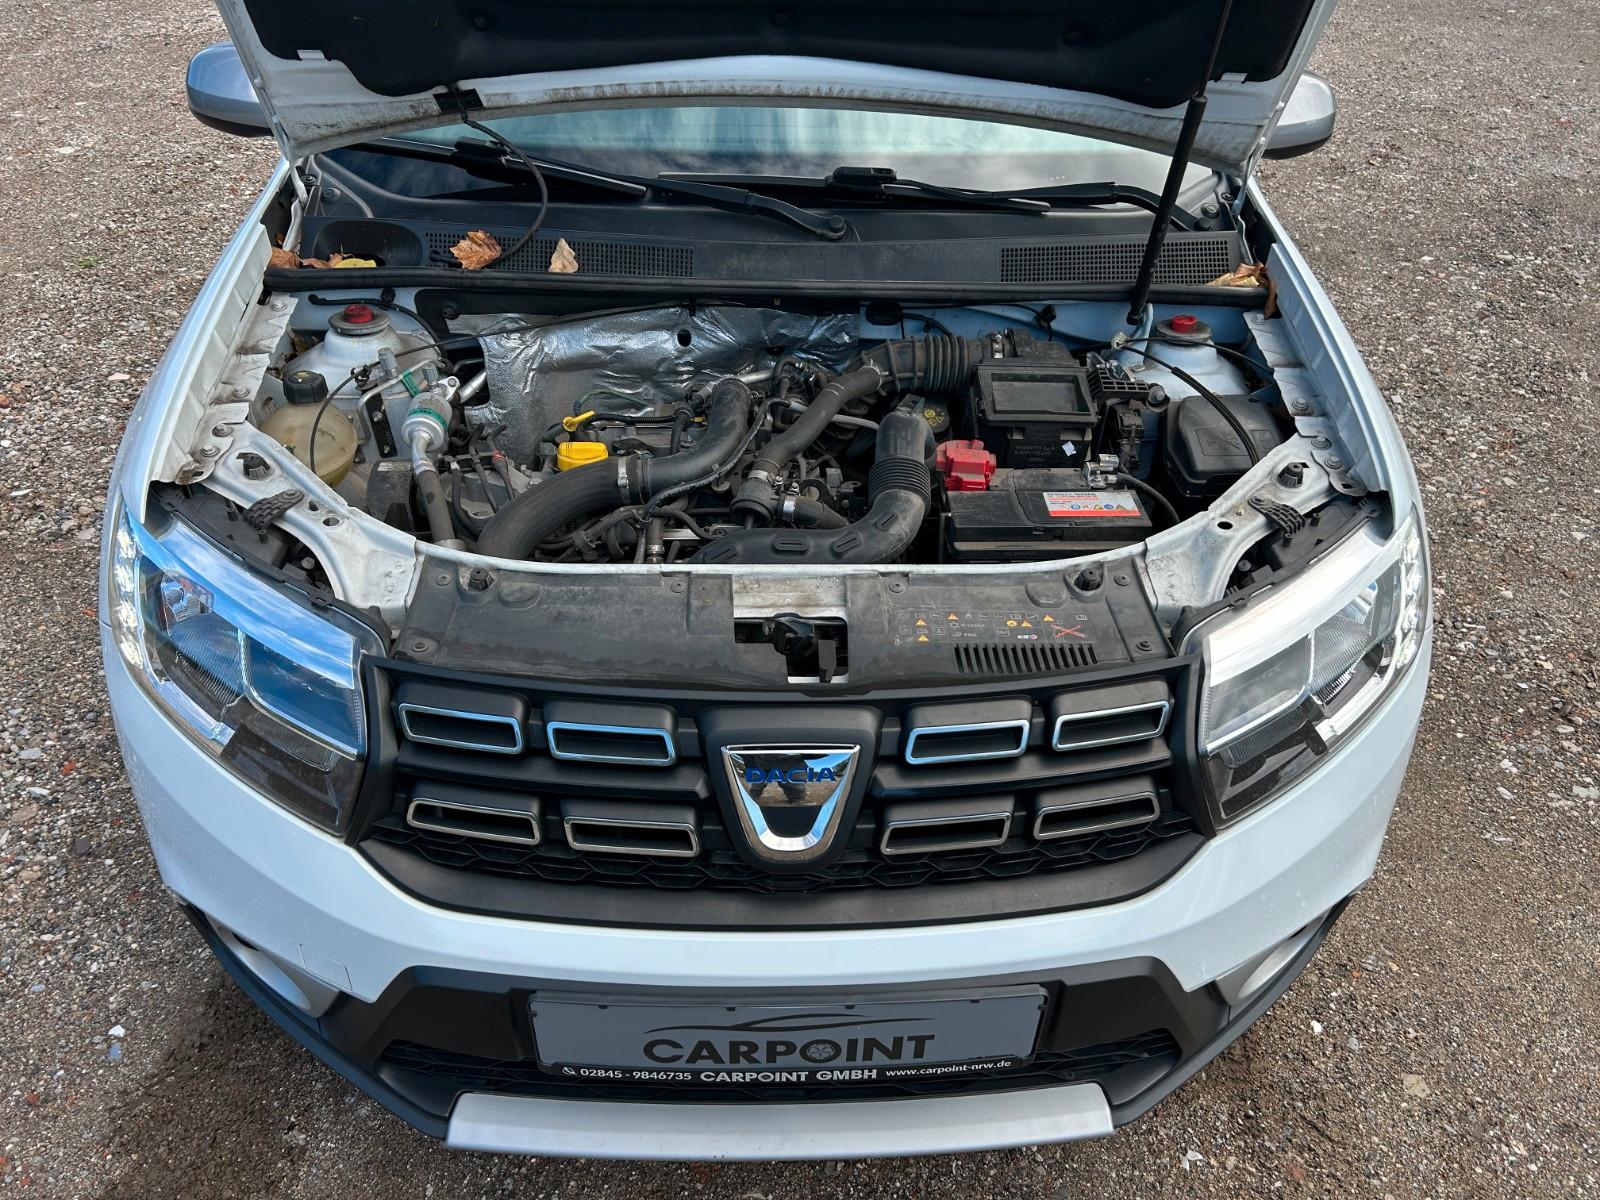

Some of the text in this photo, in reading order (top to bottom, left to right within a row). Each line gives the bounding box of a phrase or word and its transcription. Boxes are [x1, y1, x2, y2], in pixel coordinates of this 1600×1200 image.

[745, 767, 836, 783] DACIA
[643, 1035, 935, 1064] CARPOINT
[580, 1068, 622, 1078] 02845
[633, 1071, 692, 1080] 9846735
[700, 1071, 808, 1082] CARPOINT
[816, 1069, 877, 1081] GMBH
[886, 1060, 1012, 1077] www.carpoint-nrw.de
